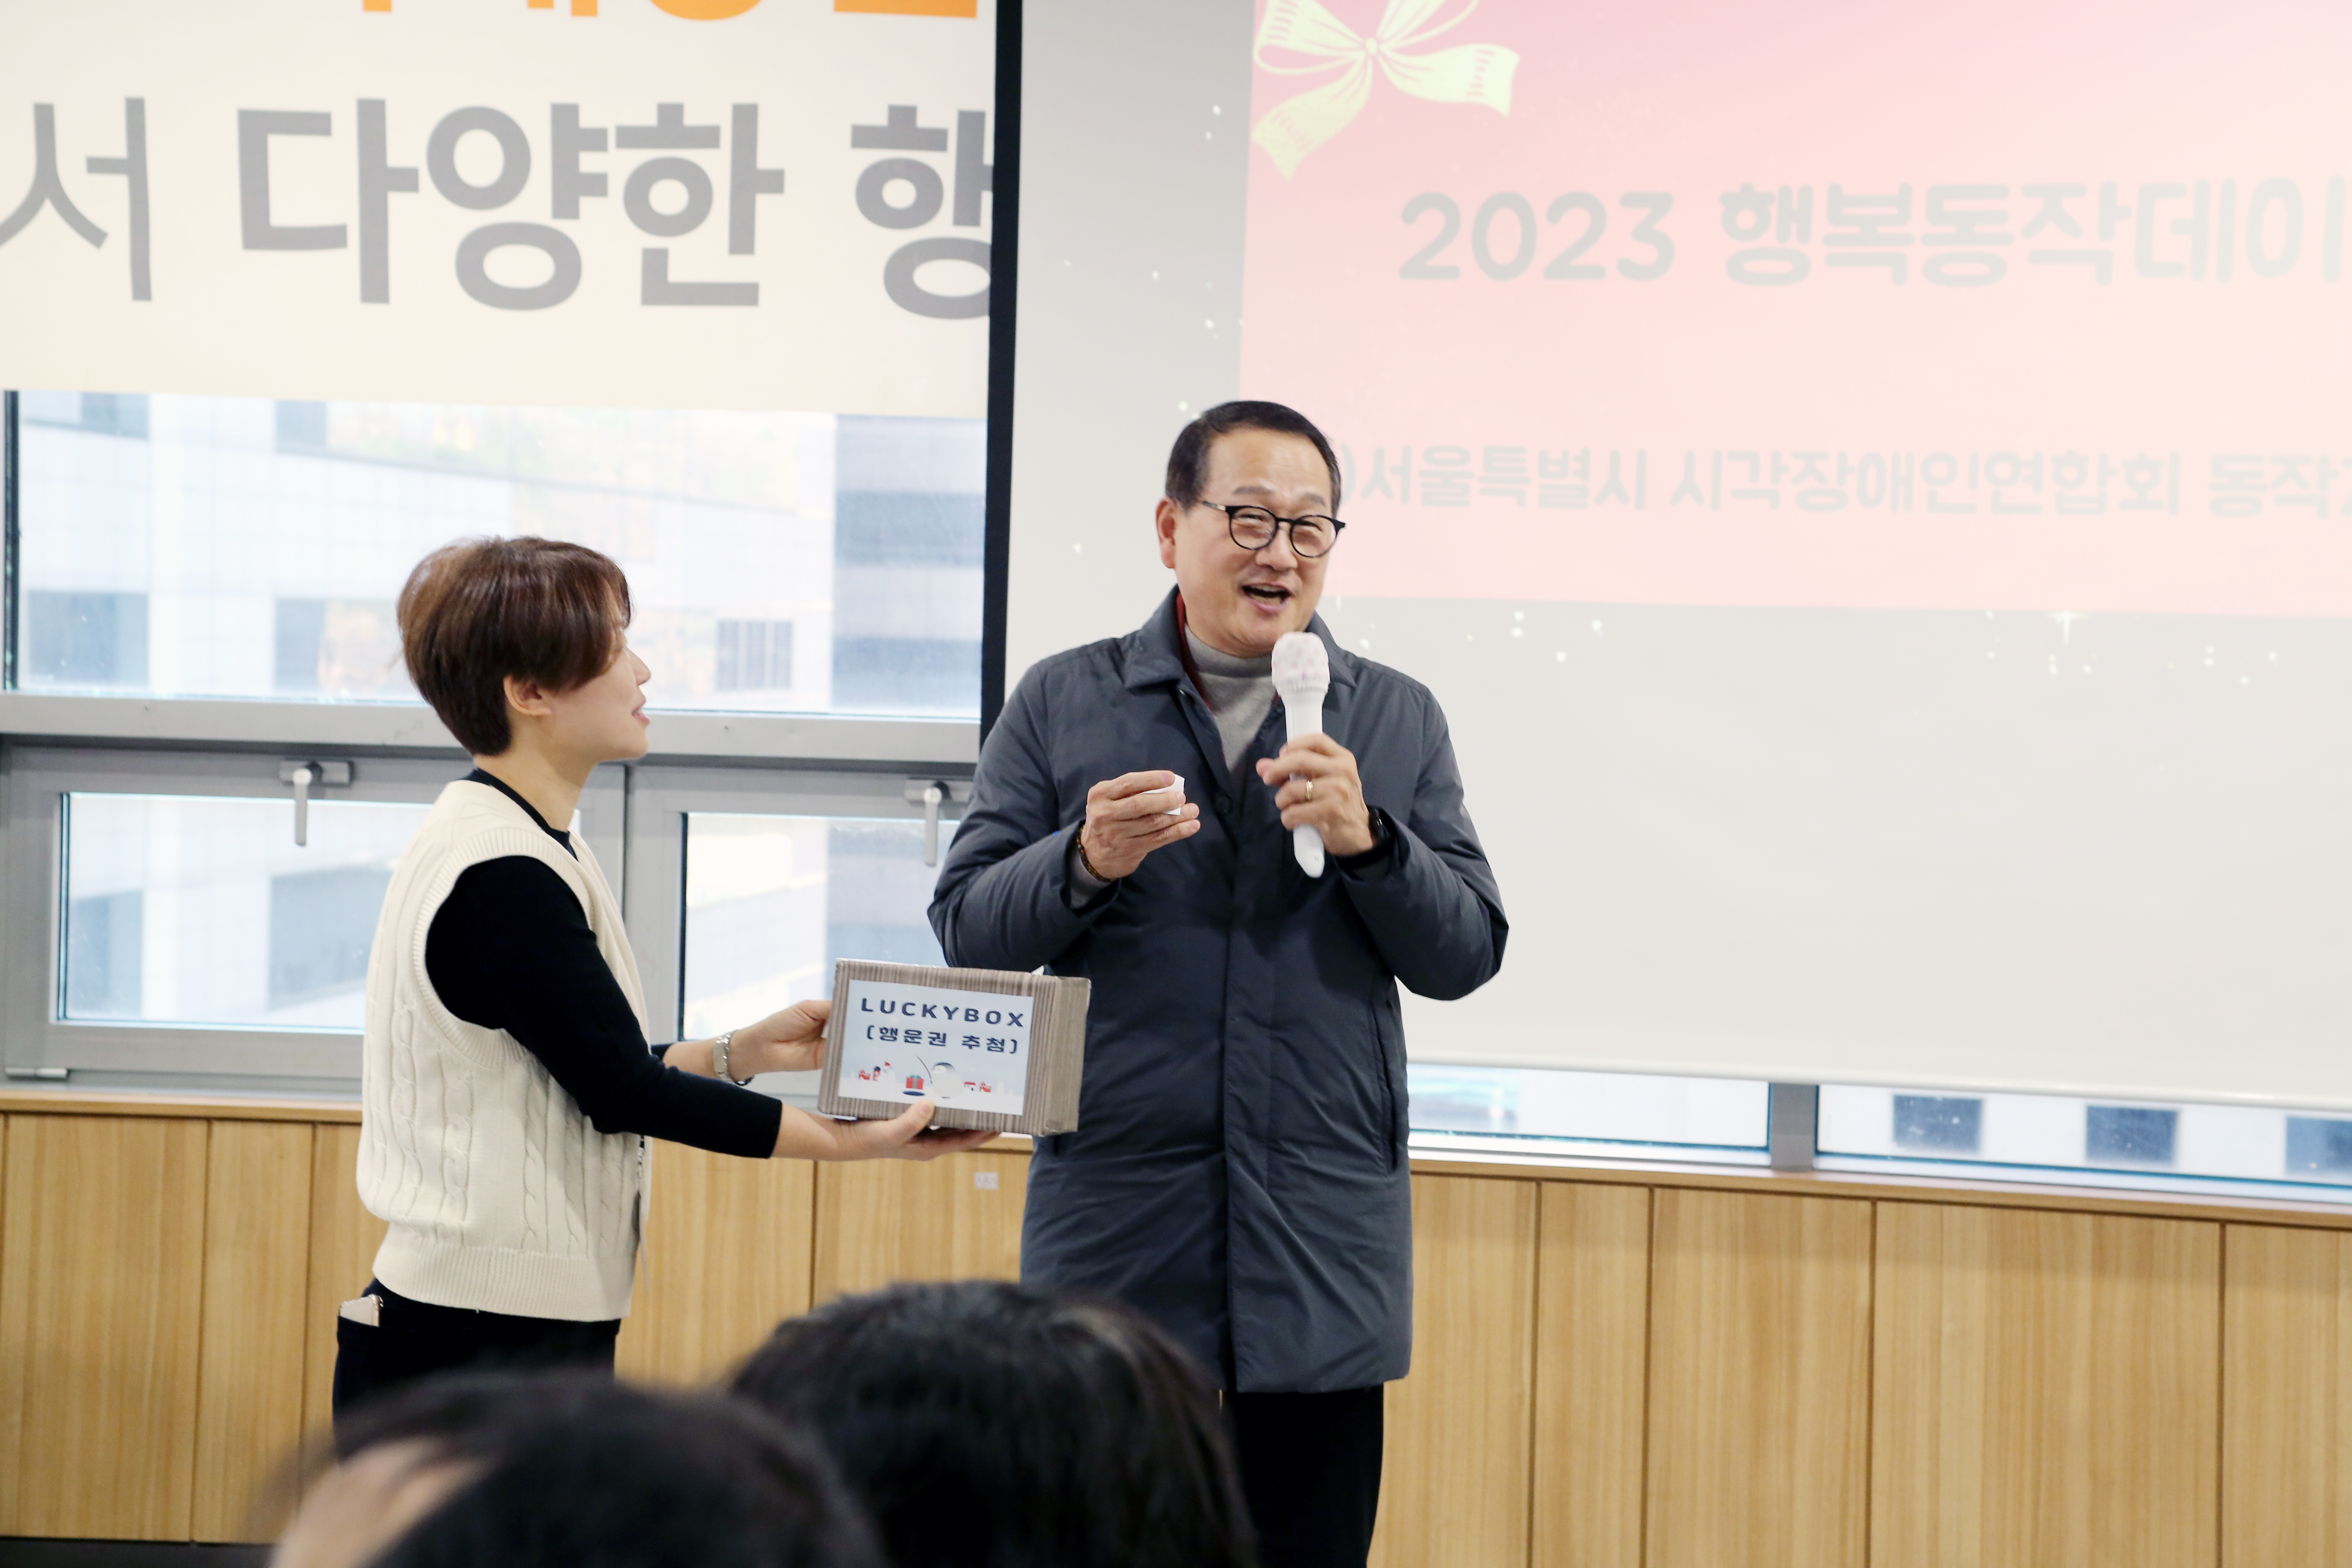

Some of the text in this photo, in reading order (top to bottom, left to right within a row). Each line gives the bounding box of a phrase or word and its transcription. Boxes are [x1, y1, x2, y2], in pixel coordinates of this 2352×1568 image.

[237, 98, 785, 311] 다양한
[1397, 175, 2346, 288] 2023 행복동작데이
[1668, 448, 2181, 516] 시각장애인연합회
[861, 998, 1023, 1027] LUCKYBOX
